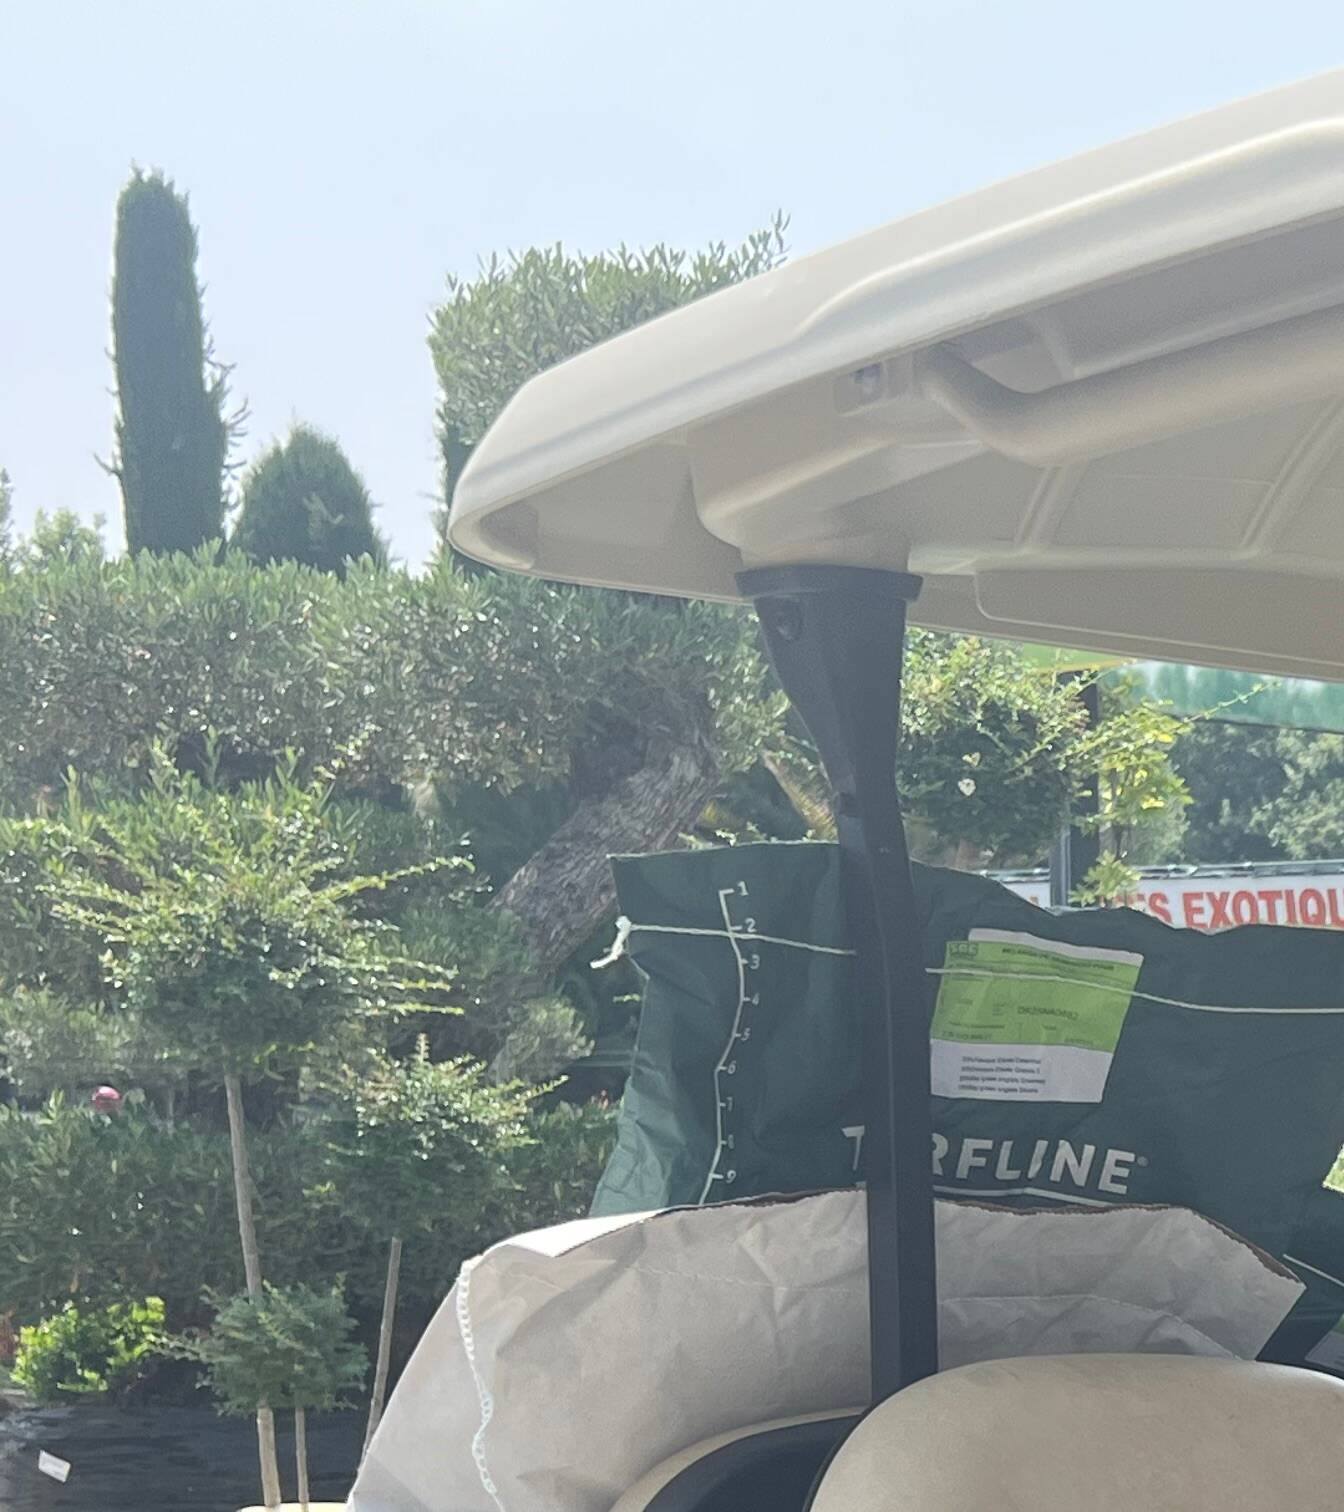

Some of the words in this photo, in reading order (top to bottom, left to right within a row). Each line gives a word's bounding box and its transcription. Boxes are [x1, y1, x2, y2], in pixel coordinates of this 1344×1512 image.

[737, 881, 749, 896] 1
[745, 917, 757, 933] 2
[750, 954, 760, 970] 3
[752, 992, 760, 1006] 4
[727, 1060, 737, 1075] 6
[841, 1124, 1136, 1195] TRFLINE
[726, 1169, 737, 1184] 9
